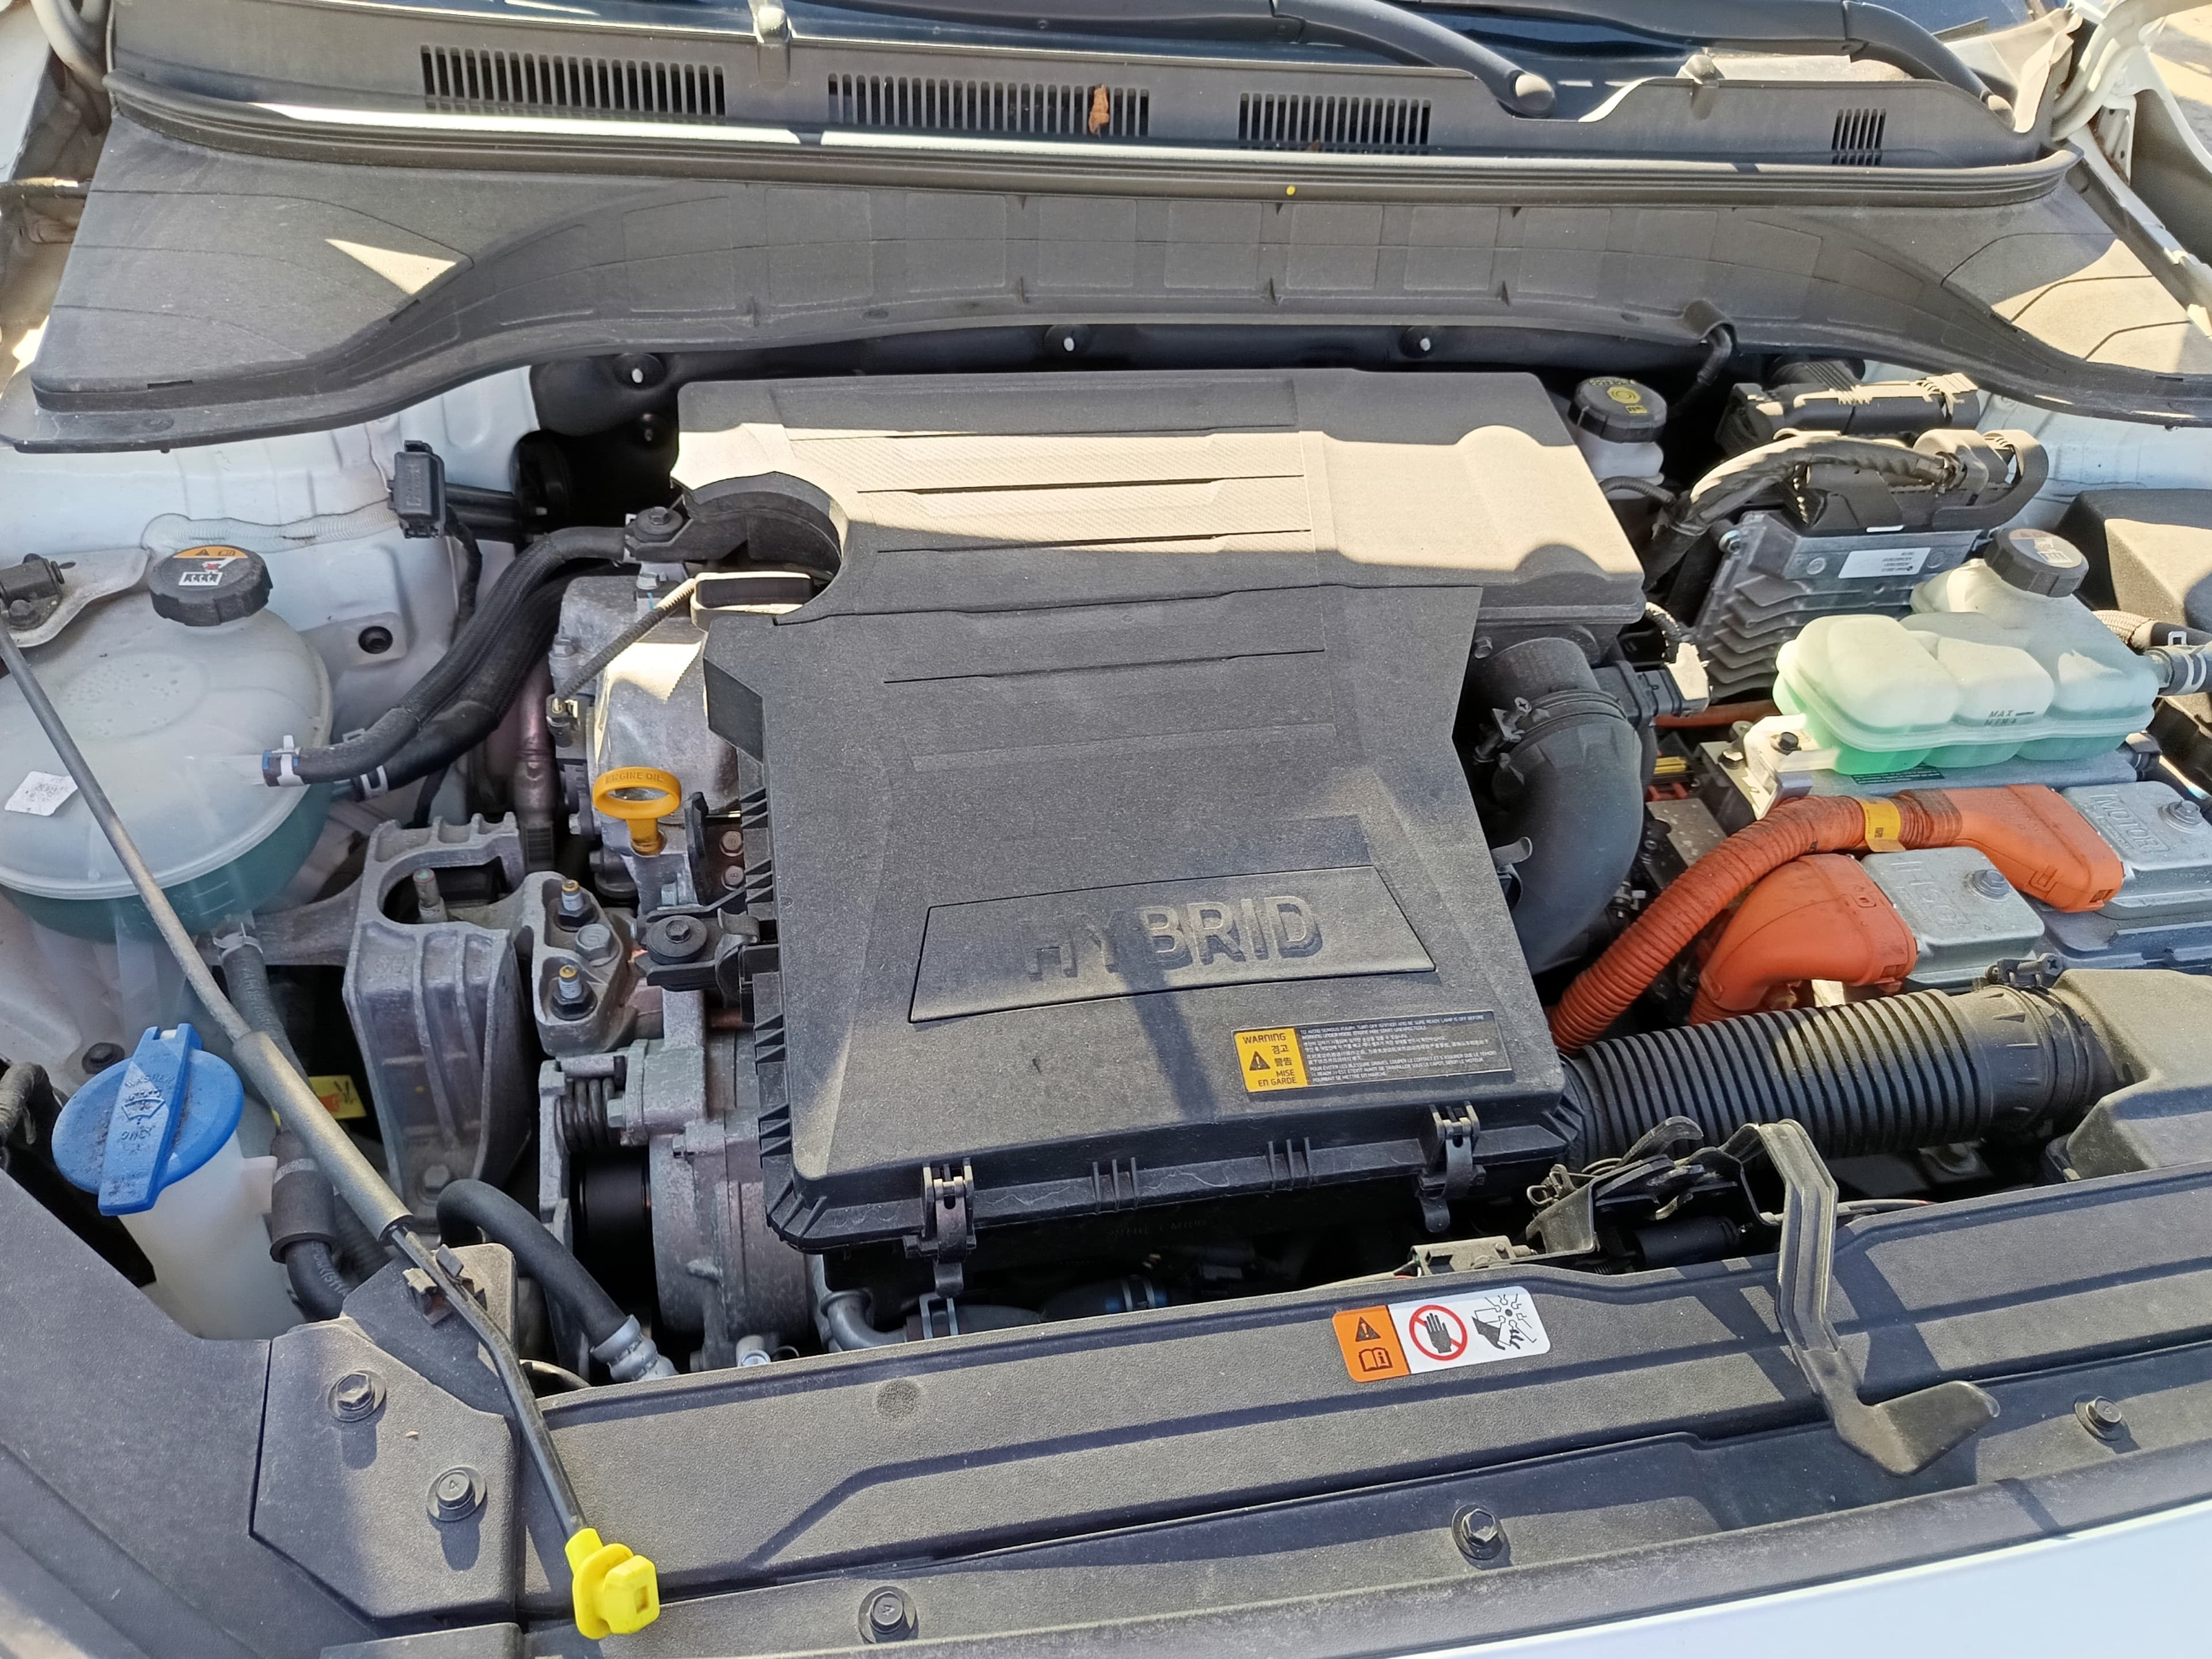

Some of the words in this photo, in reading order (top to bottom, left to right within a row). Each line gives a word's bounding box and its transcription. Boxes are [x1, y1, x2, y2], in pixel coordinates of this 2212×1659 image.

[1988, 710, 2014, 718] MAX
[605, 771, 644, 784] ENGINE
[646, 772, 664, 782] OIL
[2094, 797, 2160, 850] MOTOR
[1018, 896, 1323, 982] HYBRID
[1243, 1033, 1286, 1044] WARNING
[1271, 1044, 1289, 1055] 경고
[1276, 1069, 1296, 1077] MISE
[1258, 1079, 1268, 1087] EN
[1271, 1077, 1297, 1086] GARDE
